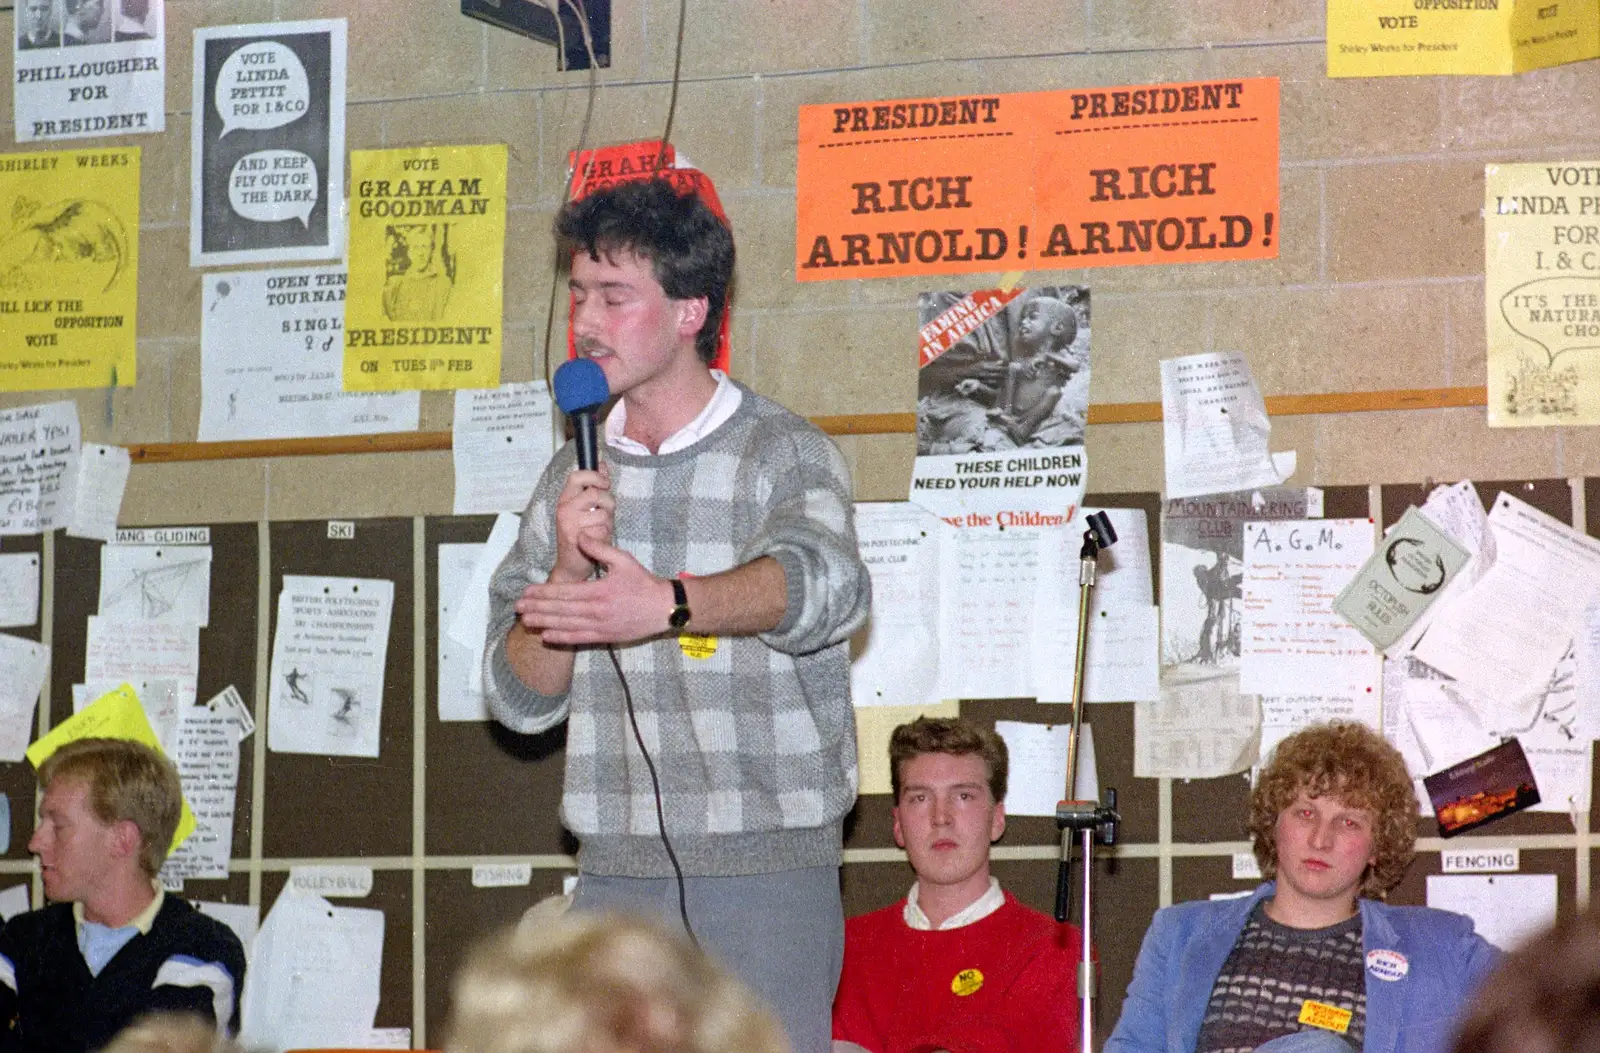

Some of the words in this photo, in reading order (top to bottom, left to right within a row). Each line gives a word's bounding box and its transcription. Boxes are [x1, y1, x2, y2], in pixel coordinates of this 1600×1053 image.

[1378, 16, 1419, 29] VOTE
[1417, 42, 1459, 52] President
[240, 52, 276, 64] VOTE
[17, 66, 66, 83] PHIL
[68, 57, 159, 78] LOUGHER
[236, 69, 289, 82] LINDA
[68, 85, 109, 102] FOR
[230, 86, 286, 99] PETTIT
[233, 103, 262, 116] FOR
[1070, 83, 1244, 121] PRESIDENT
[833, 98, 1001, 134] PRESIDENT
[32, 112, 148, 136] PRESIDENT
[76, 153, 129, 168] WEEKS
[238, 158, 267, 171] AND
[273, 156, 309, 170] KEEP
[403, 158, 440, 171] VOTE
[234, 175, 257, 188] FLY
[261, 173, 288, 186] OUT
[291, 172, 310, 185] OF
[1089, 162, 1217, 202] RICH
[359, 178, 482, 198] GRAHAM
[851, 176, 973, 215] RICH
[241, 191, 268, 204] THE
[273, 189, 312, 203] DARK
[359, 198, 490, 218] GOODMAN
[1496, 196, 1570, 216] LINDA
[1554, 225, 1600, 245] FOR
[1556, 251, 1573, 270] &
[266, 275, 310, 289] OPEN
[315, 273, 347, 286] TEN
[0, 301, 20, 314] ILL
[23, 300, 53, 313] LICK
[56, 300, 84, 313] THE
[1514, 295, 1548, 308] IT'S
[1562, 294, 1598, 308] THE
[54, 315, 124, 329] OPPOSITION
[921, 296, 976, 341] FAMINE
[1529, 309, 1600, 323] NATURA
[282, 318, 342, 333] SINGL
[923, 340, 946, 360] IN
[949, 296, 1002, 339] AFRICA
[1564, 324, 1600, 337] CHO
[25, 333, 58, 347] VOTE
[346, 326, 493, 348] PRESIDENT
[360, 360, 379, 373] ON
[393, 359, 427, 372] TUES
[447, 359, 473, 372] FEB
[955, 462, 1002, 474] THESE
[1007, 455, 1081, 472] CHILDREN
[914, 478, 956, 490] NEED
[959, 476, 1000, 490] YOUR
[1004, 475, 1043, 488] HELP
[1046, 473, 1081, 487] NOW
[966, 512, 992, 527] the
[996, 510, 1063, 529] Children
[1198, 519, 1232, 534] CLUB
[329, 523, 352, 537] SKI
[1446, 855, 1515, 869] FENCING
[475, 870, 523, 882] FISHING
